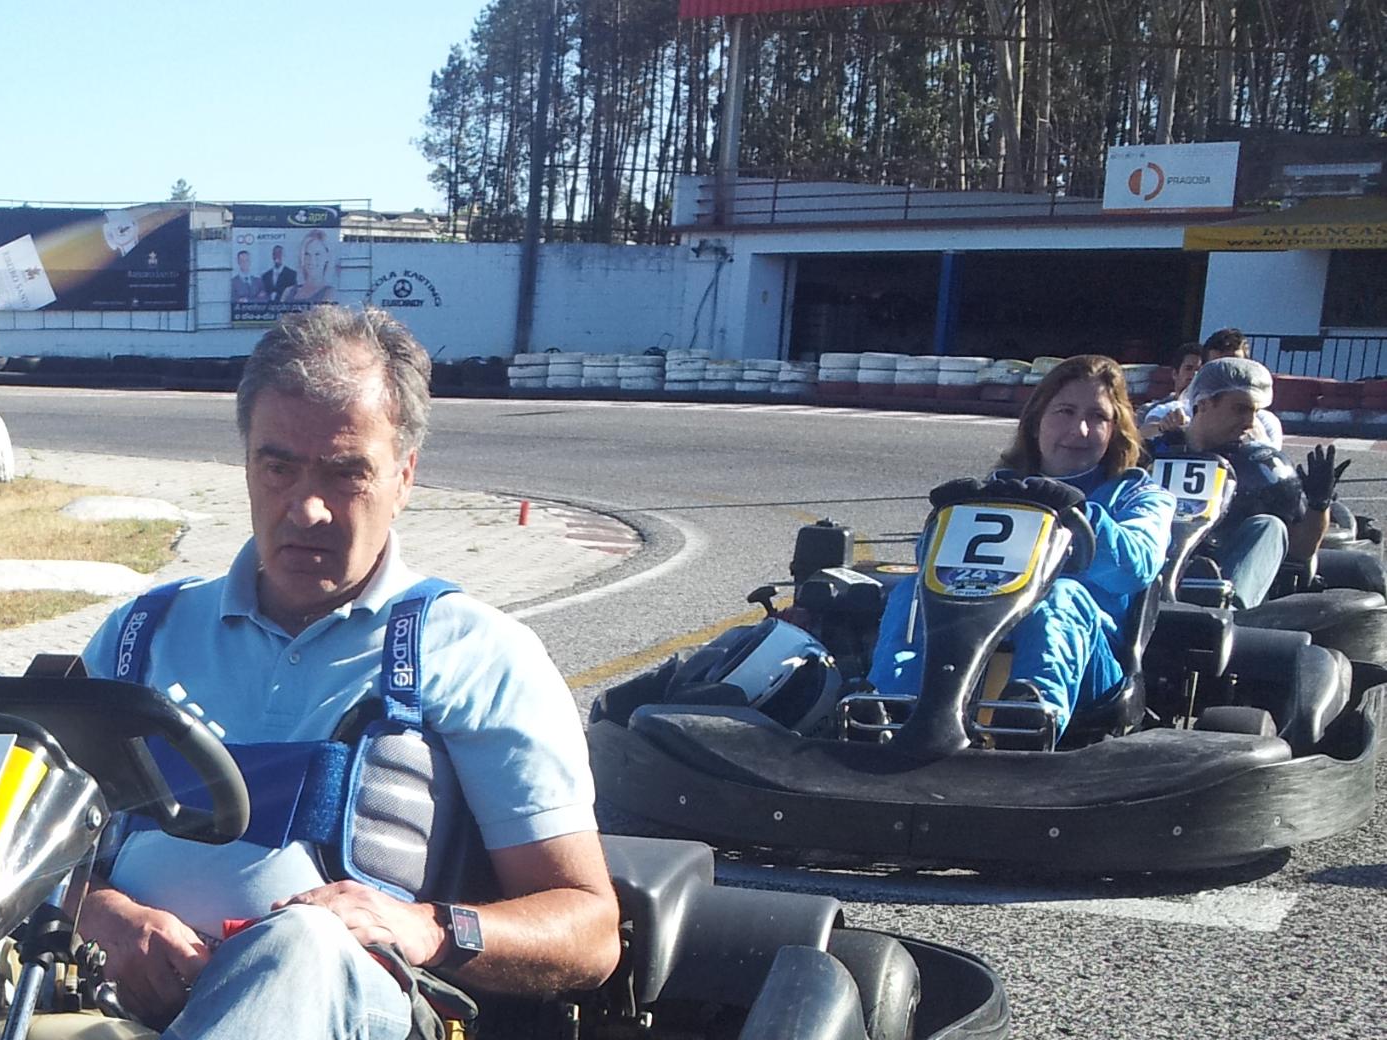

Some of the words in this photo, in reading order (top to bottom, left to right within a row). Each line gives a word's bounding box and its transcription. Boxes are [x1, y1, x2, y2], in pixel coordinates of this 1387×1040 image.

[403, 268, 443, 307] KARTING
[1161, 462, 1206, 494] 15
[963, 513, 1014, 565] 2
[955, 568, 988, 581] 24
[117, 611, 148, 678] sparco
[392, 617, 414, 687] sparco
